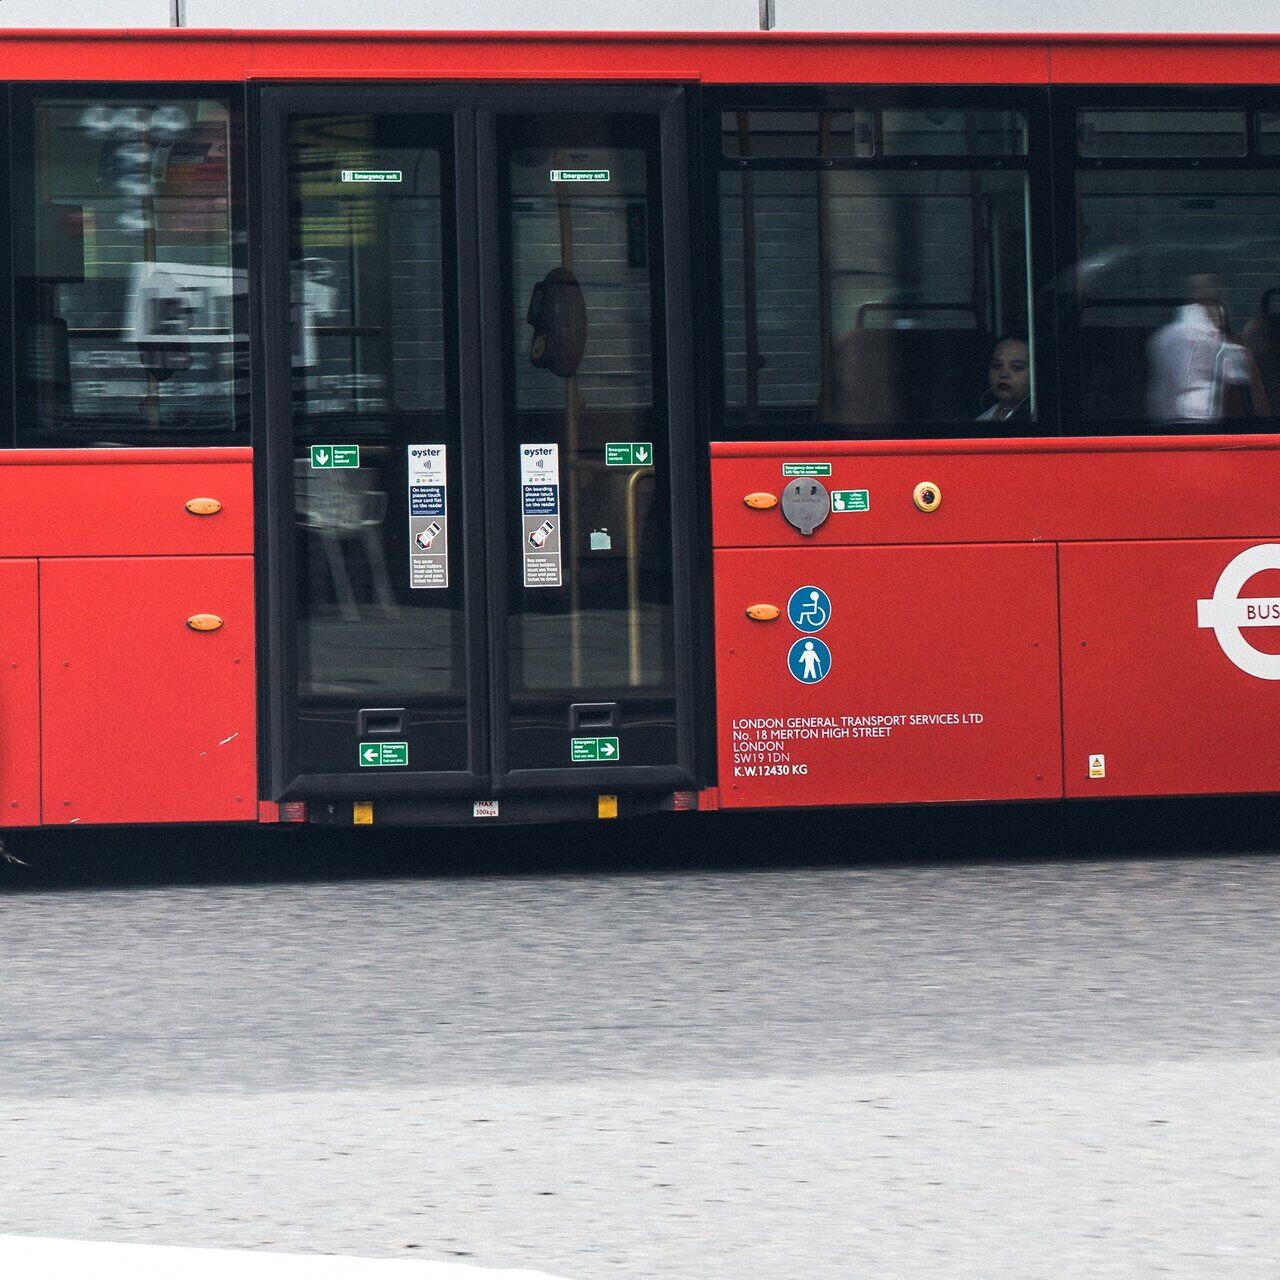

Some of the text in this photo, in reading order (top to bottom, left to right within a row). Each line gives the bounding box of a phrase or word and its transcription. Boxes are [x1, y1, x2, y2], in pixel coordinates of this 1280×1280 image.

[354, 173, 385, 181] Emergency
[411, 448, 441, 459] oyster
[524, 447, 553, 458] oyster
[1247, 605, 1280, 619] BUS
[732, 713, 984, 729] LONDON GENERAL TRANSPORT SERVICES LTD
[732, 727, 893, 741] No. 18 MERTON HIGH STREET
[733, 741, 785, 752] LONDON
[734, 752, 790, 763] SW19 1DN
[734, 764, 808, 777] K.W.12430 KG
